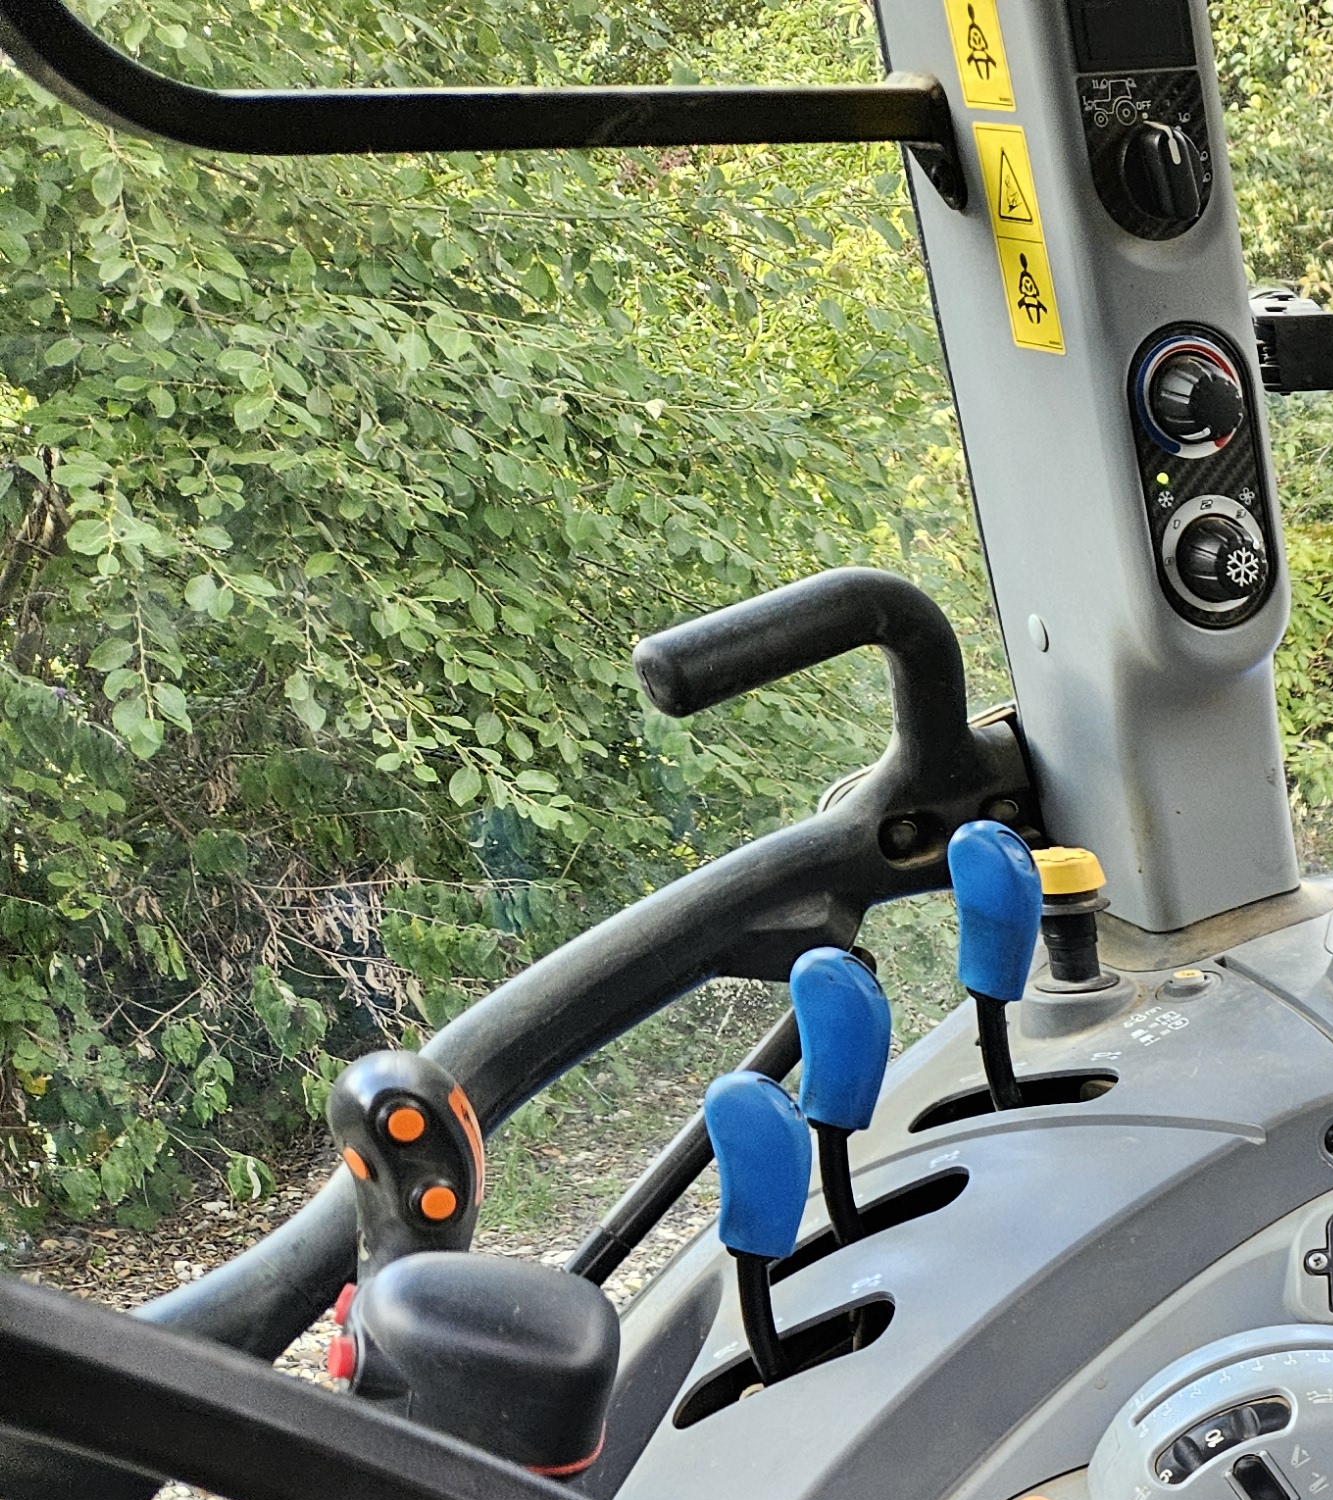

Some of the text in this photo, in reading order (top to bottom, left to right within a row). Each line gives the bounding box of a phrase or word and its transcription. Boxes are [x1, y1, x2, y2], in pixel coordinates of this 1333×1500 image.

[1136, 100, 1152, 110] OFF
[1200, 499, 1213, 510] 2
[1236, 509, 1246, 519] 3
[1205, 1429, 1225, 1448] 10
